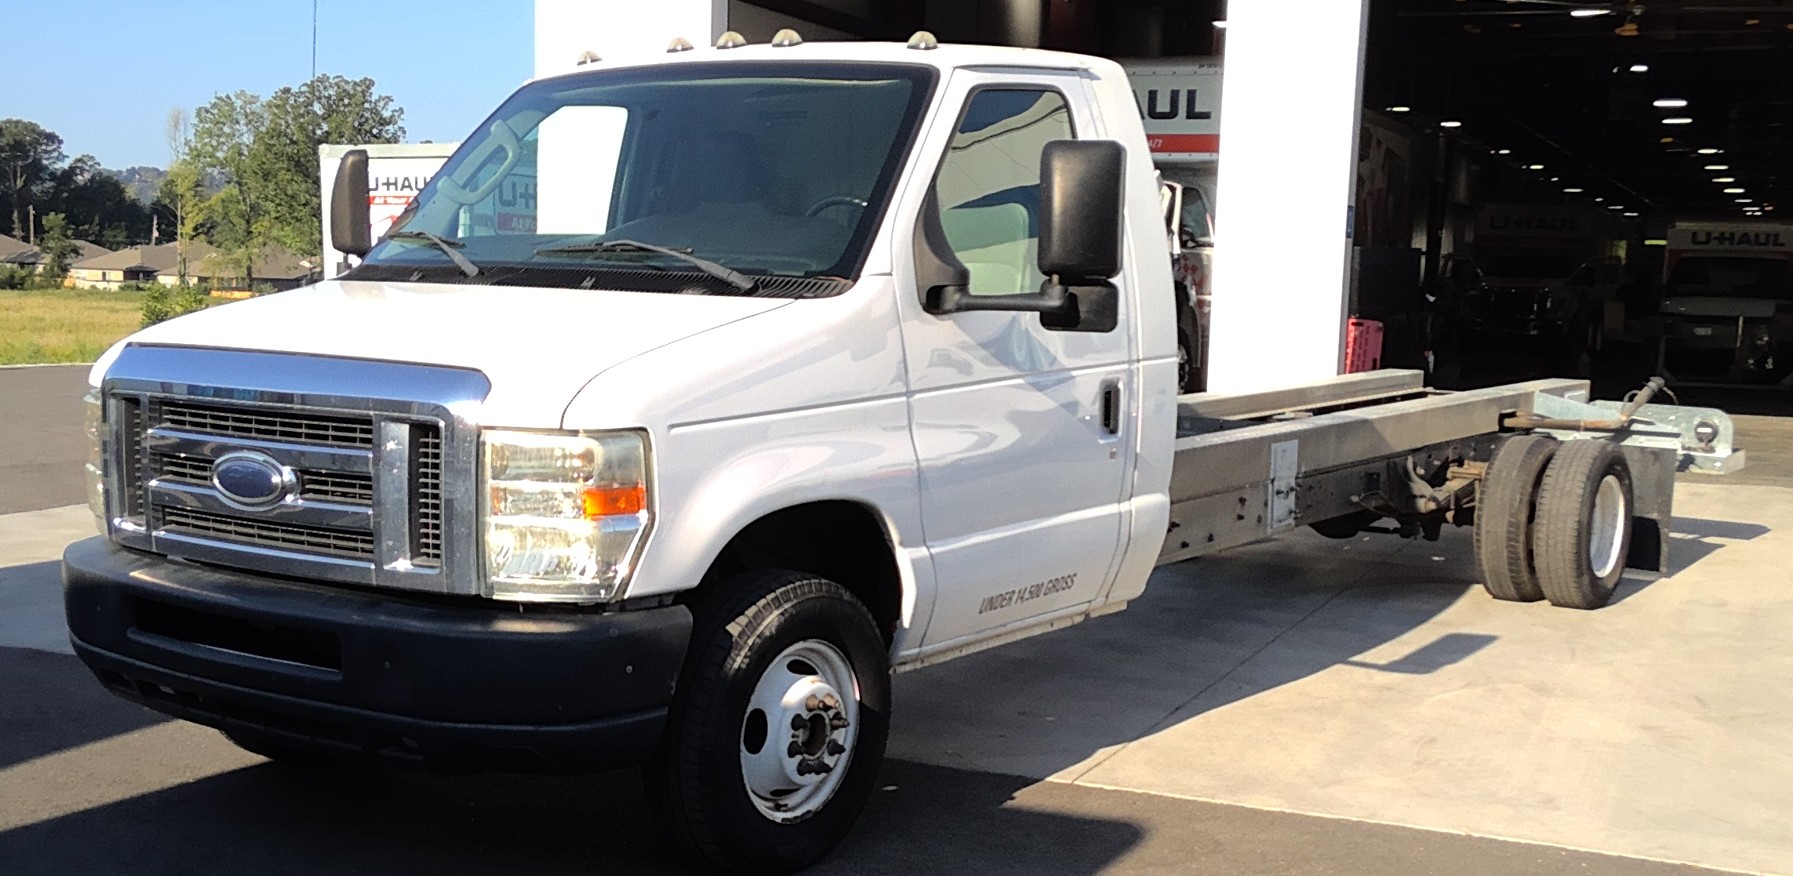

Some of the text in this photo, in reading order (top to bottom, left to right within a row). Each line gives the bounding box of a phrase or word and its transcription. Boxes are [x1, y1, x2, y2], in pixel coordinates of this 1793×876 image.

[1490, 216, 1581, 231] U-HAUL
[1691, 231, 1786, 247] U-HAUL
[978, 589, 1016, 615] UNDER
[1043, 572, 1078, 597] GROSS
